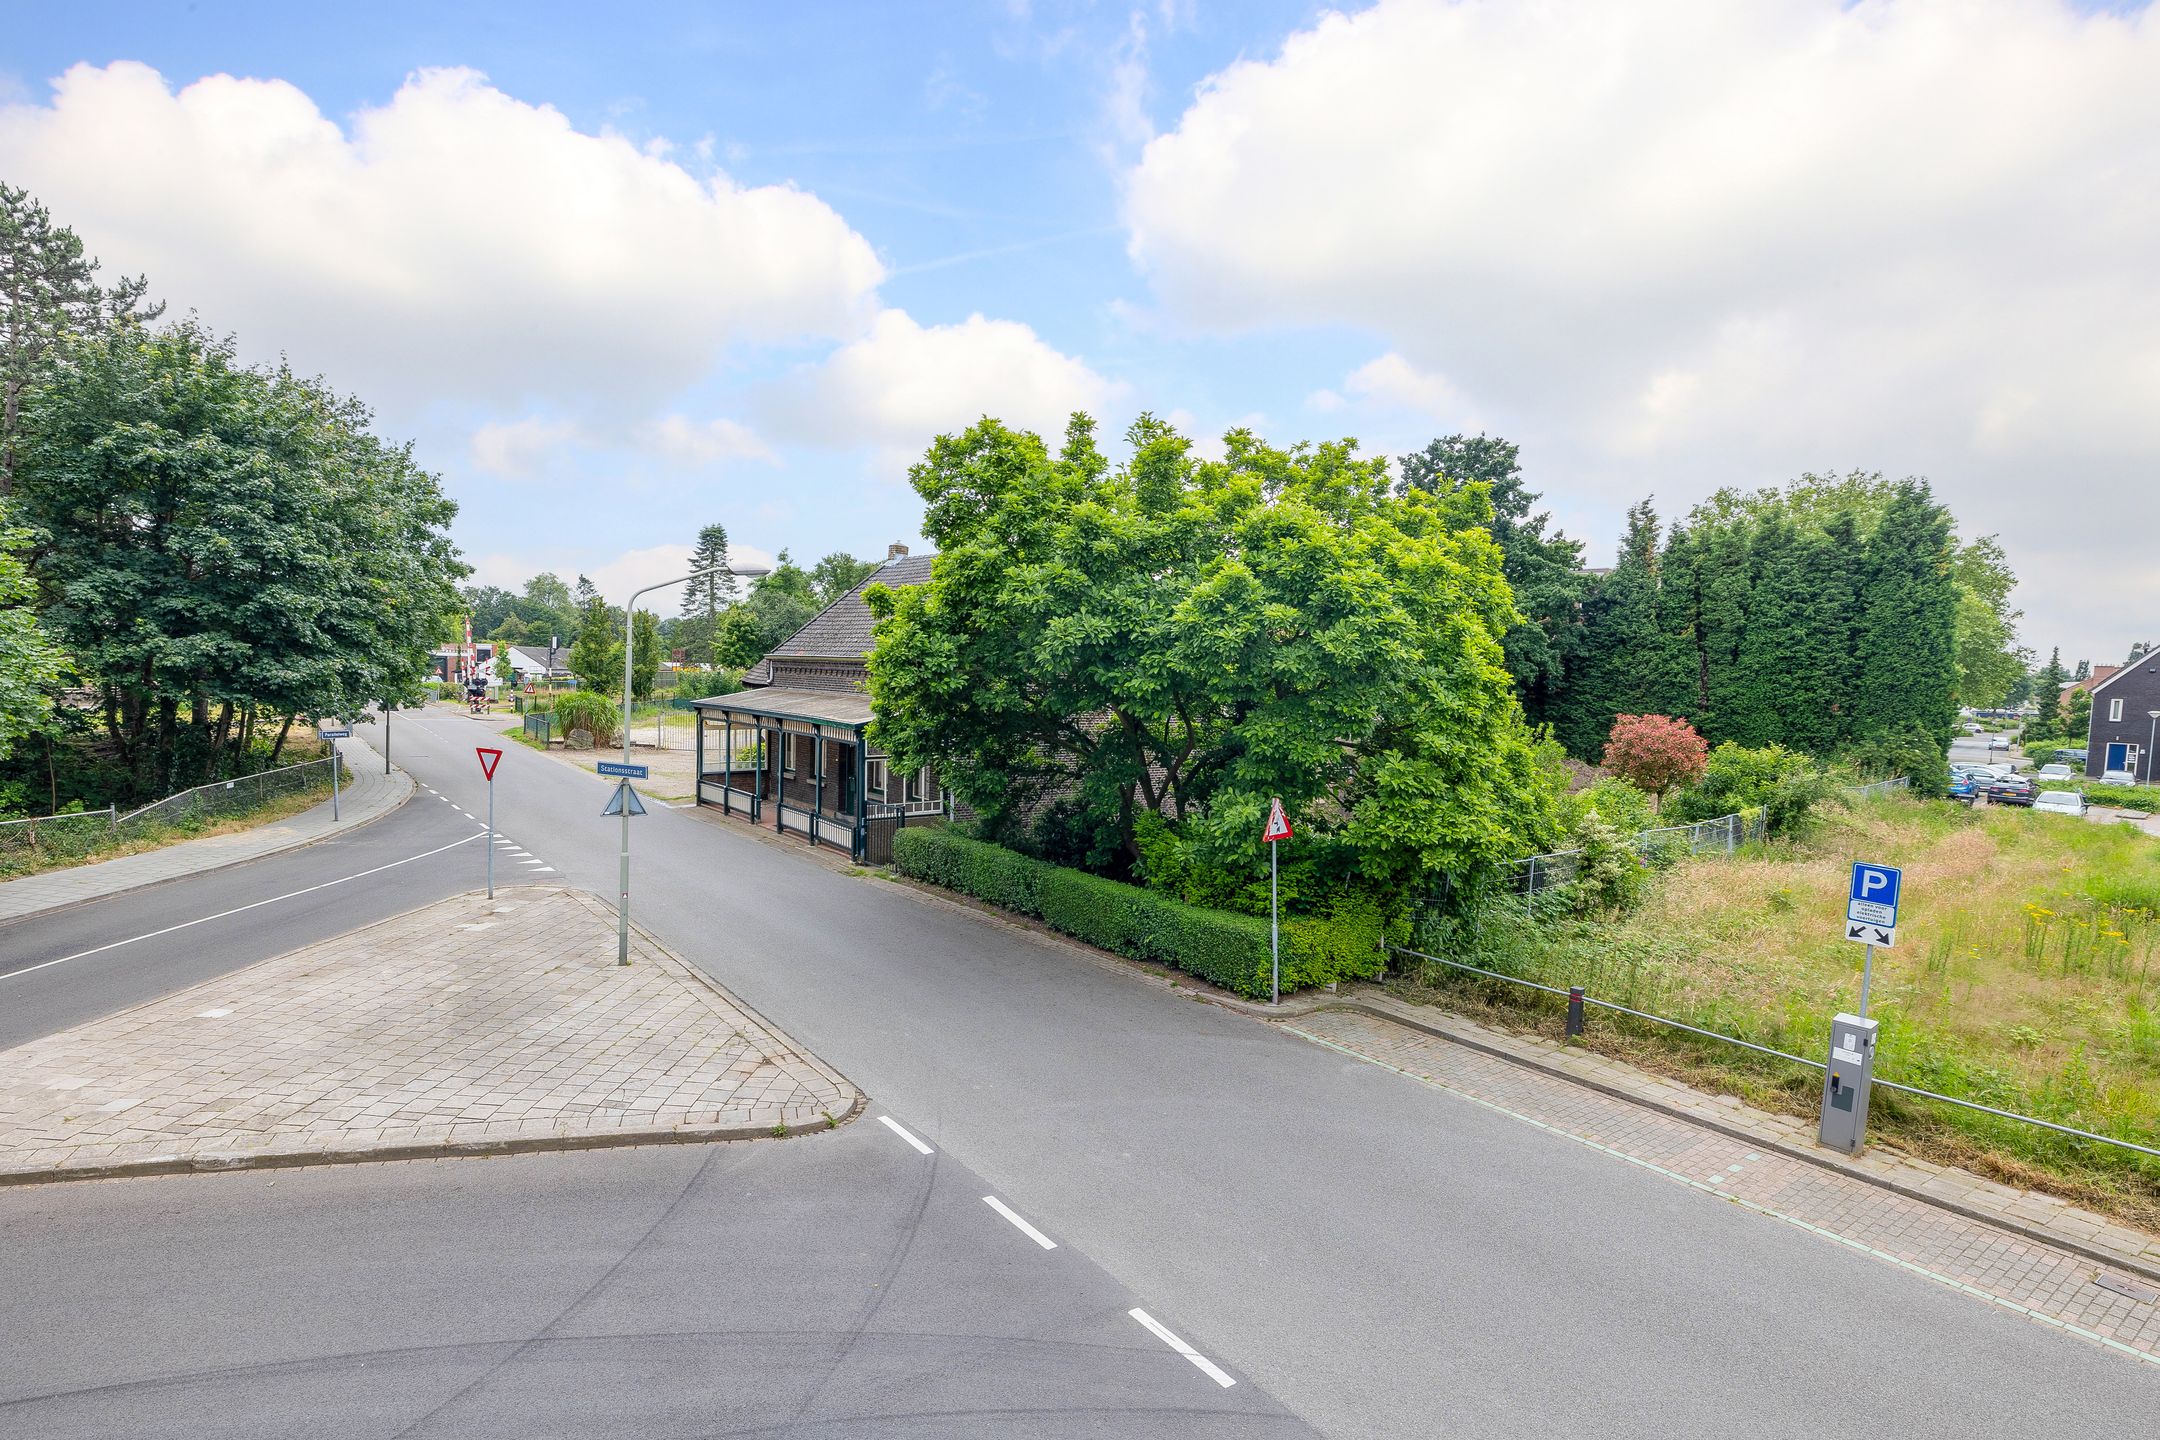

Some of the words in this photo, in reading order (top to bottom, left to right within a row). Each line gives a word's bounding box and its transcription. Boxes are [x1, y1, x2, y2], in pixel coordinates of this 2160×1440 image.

[600, 765, 643, 776] Stationsstraat
[1861, 869, 1888, 898] P
[1856, 911, 1886, 919] elektrische
